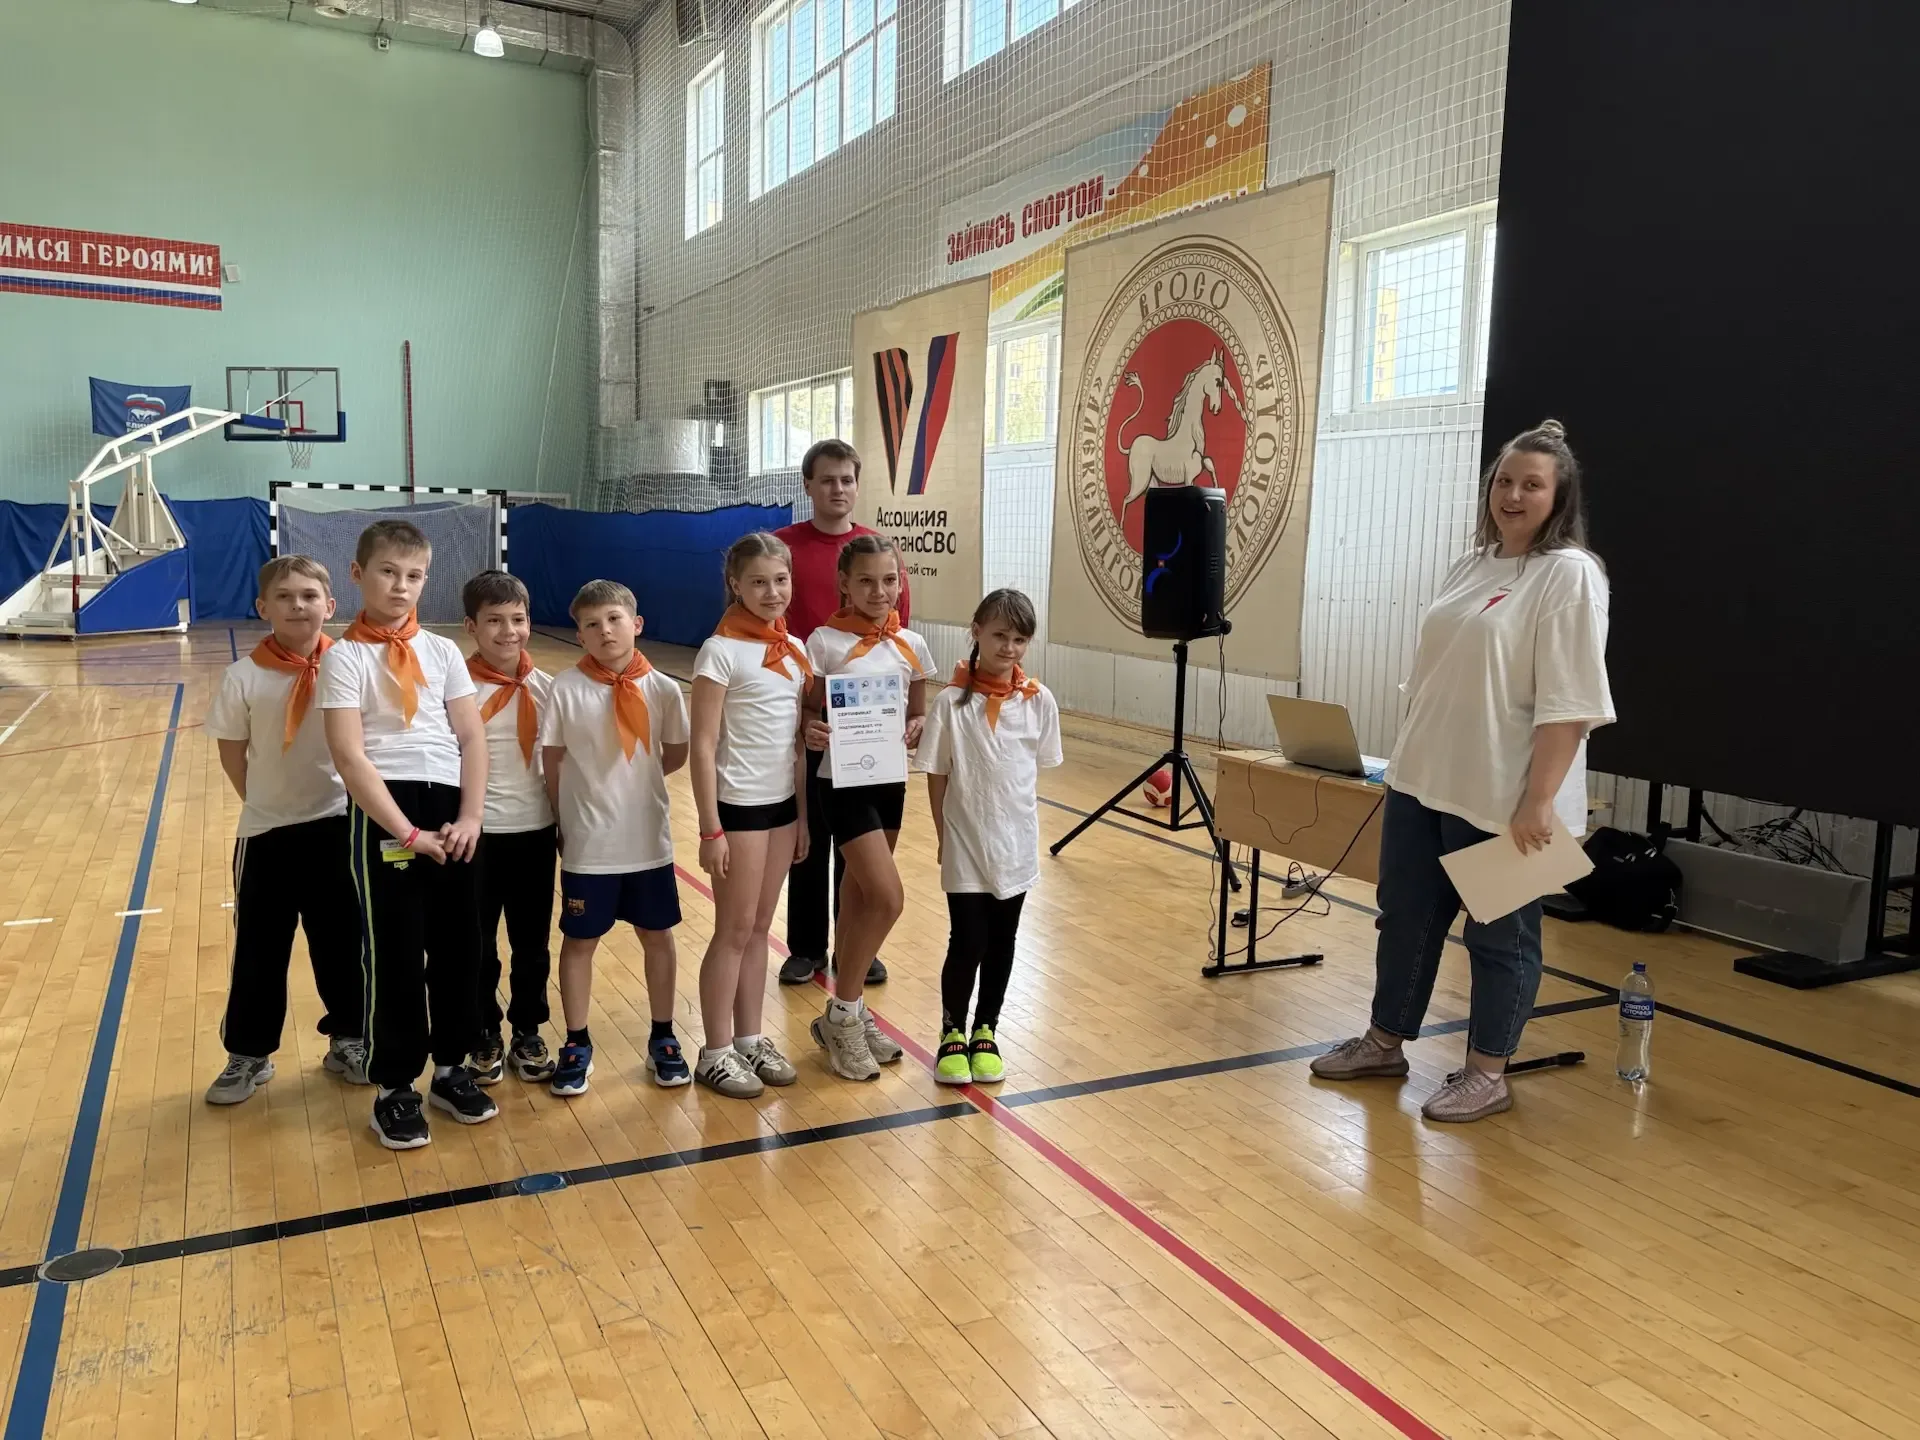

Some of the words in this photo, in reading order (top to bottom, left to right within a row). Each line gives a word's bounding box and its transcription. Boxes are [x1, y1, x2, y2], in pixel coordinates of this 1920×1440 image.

[947, 212, 1015, 265] ЗАЙМИСЬ
[1022, 175, 1104, 239] СПОРТОМ
[81, 242, 213, 276] ГЕРОЯМИ!
